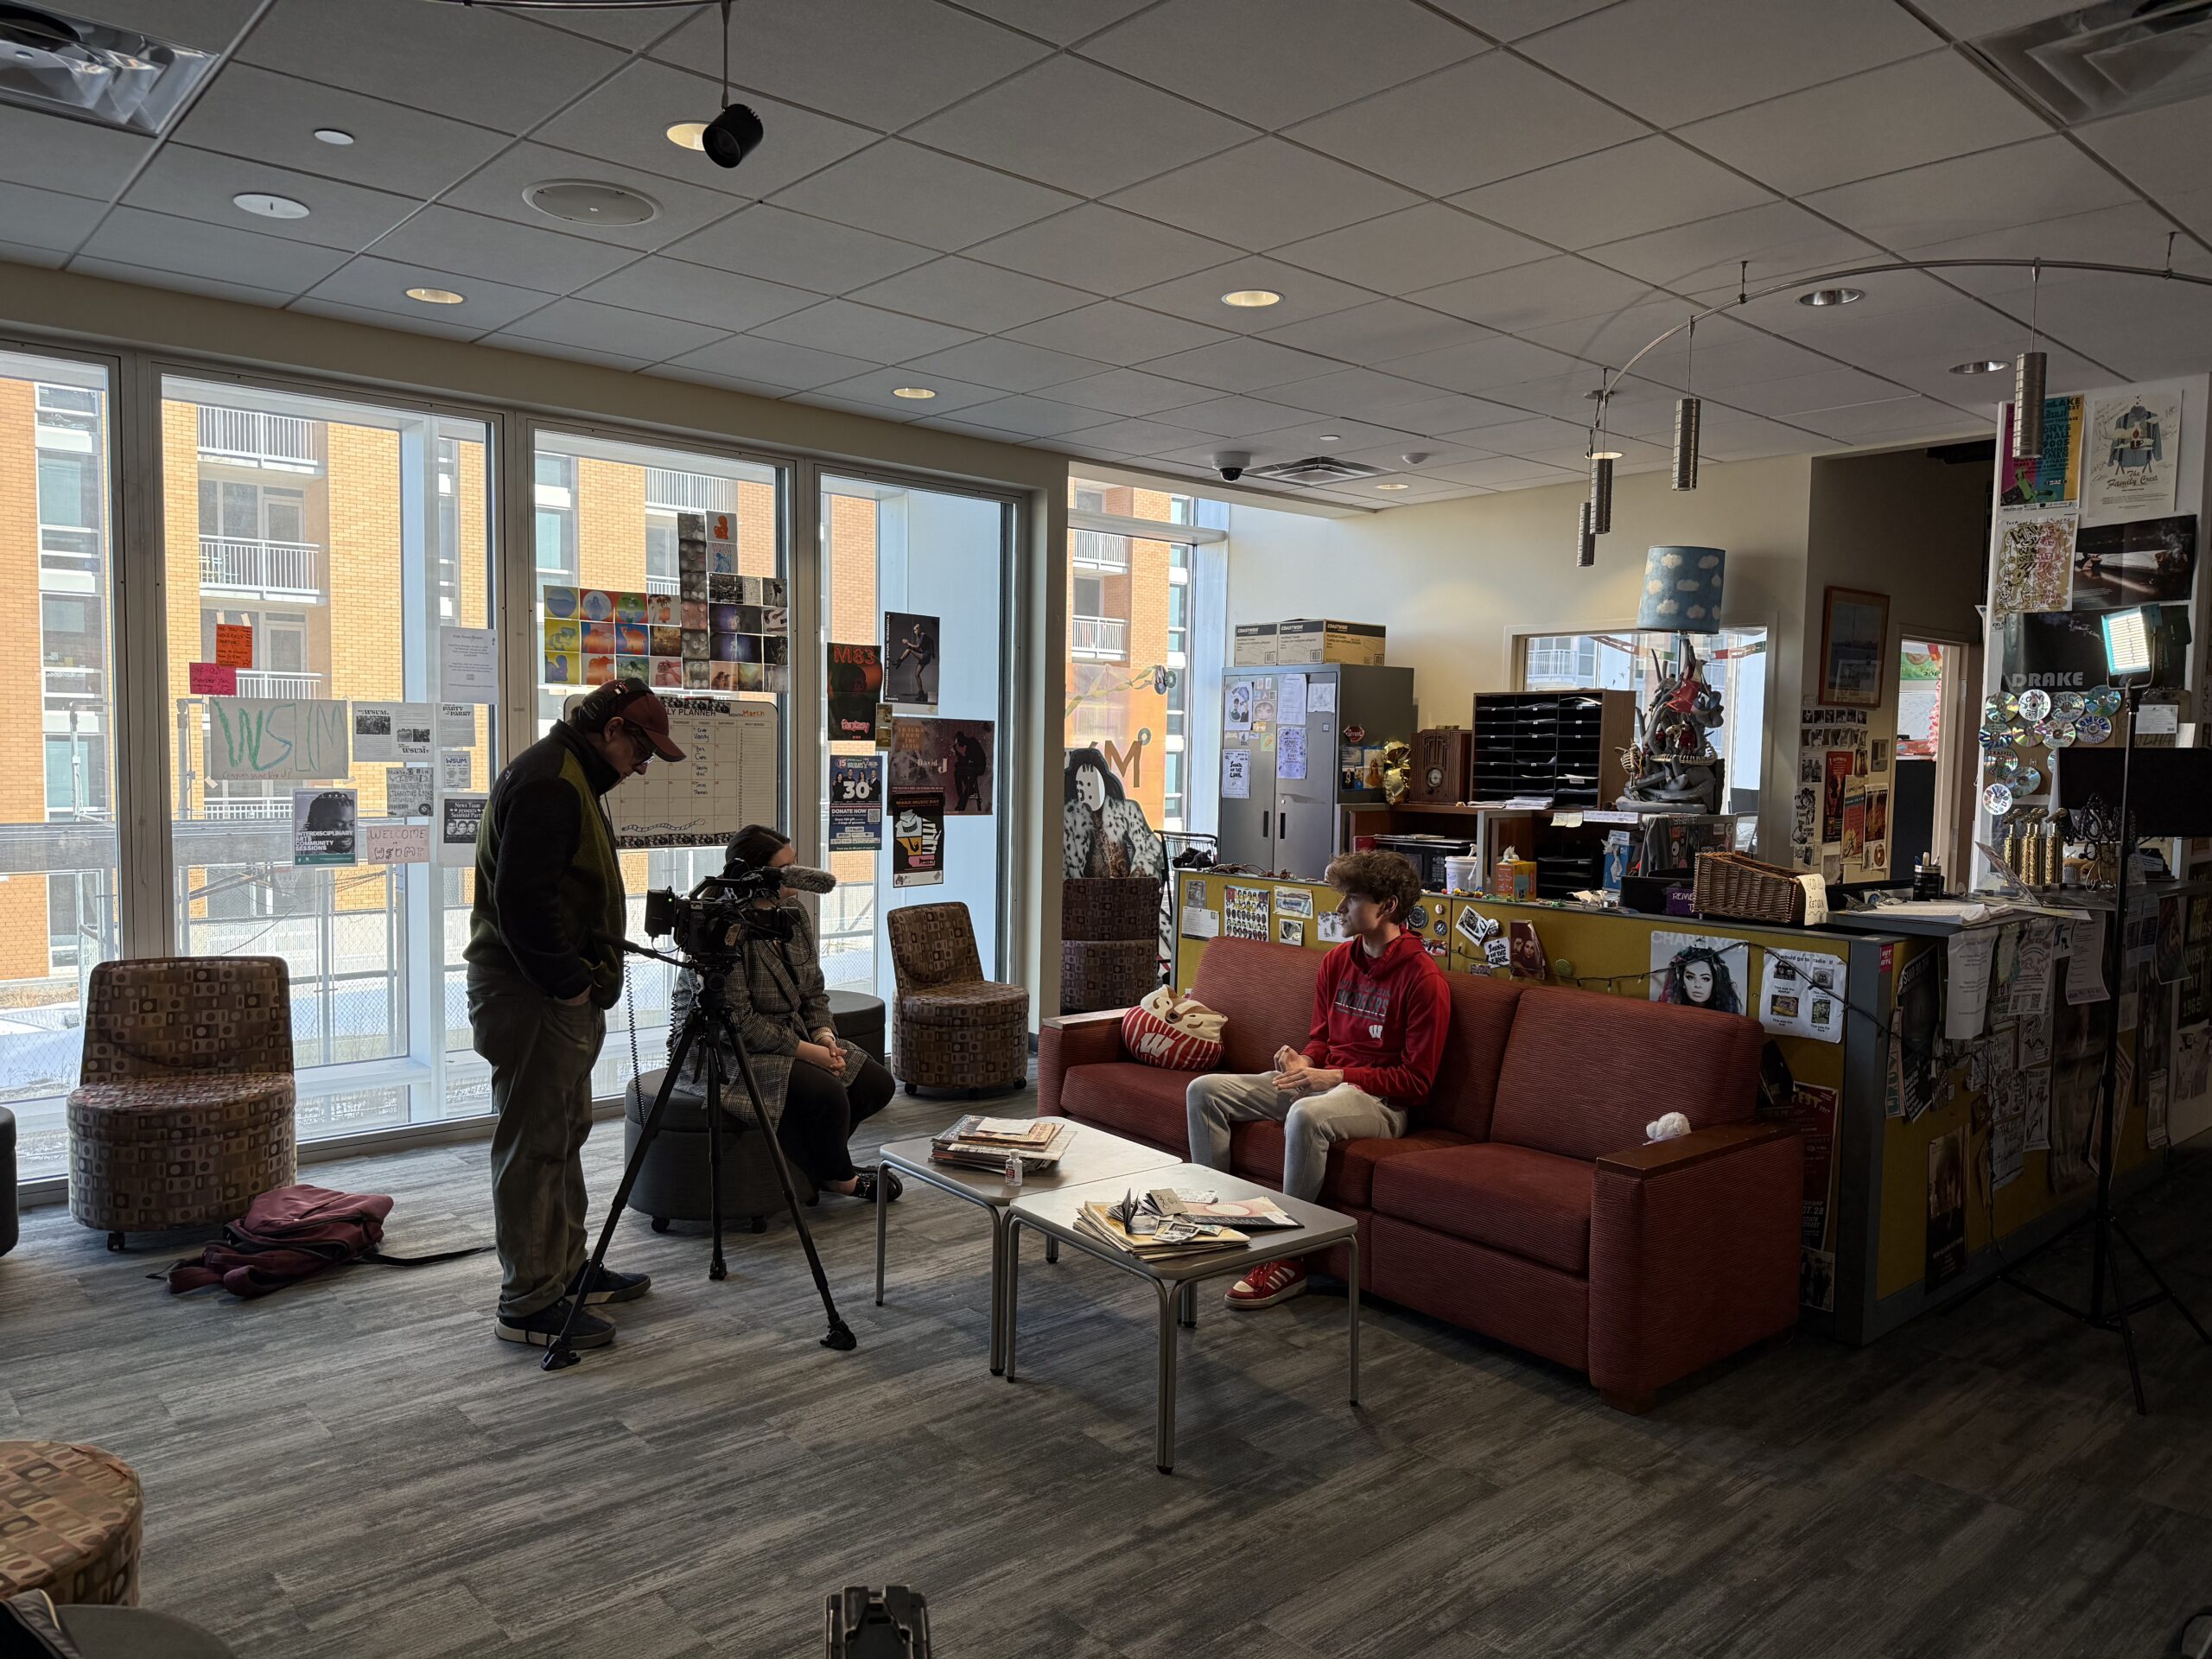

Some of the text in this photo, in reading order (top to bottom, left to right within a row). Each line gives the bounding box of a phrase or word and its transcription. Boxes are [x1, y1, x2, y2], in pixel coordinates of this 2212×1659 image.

[2053, 397, 2081, 407] LAKE
[2107, 475, 2158, 490] Family Crest
[833, 645, 874, 664] M83
[2012, 672, 2083, 688] DRAKE
[842, 719, 870, 733] fantasy
[213, 698, 347, 774] WSUM
[938, 758, 947, 773] J
[843, 781, 870, 799] 30
[370, 829, 426, 840] WELCOME
[1369, 1025, 1382, 1039] W
[1140, 1033, 1175, 1058] W
